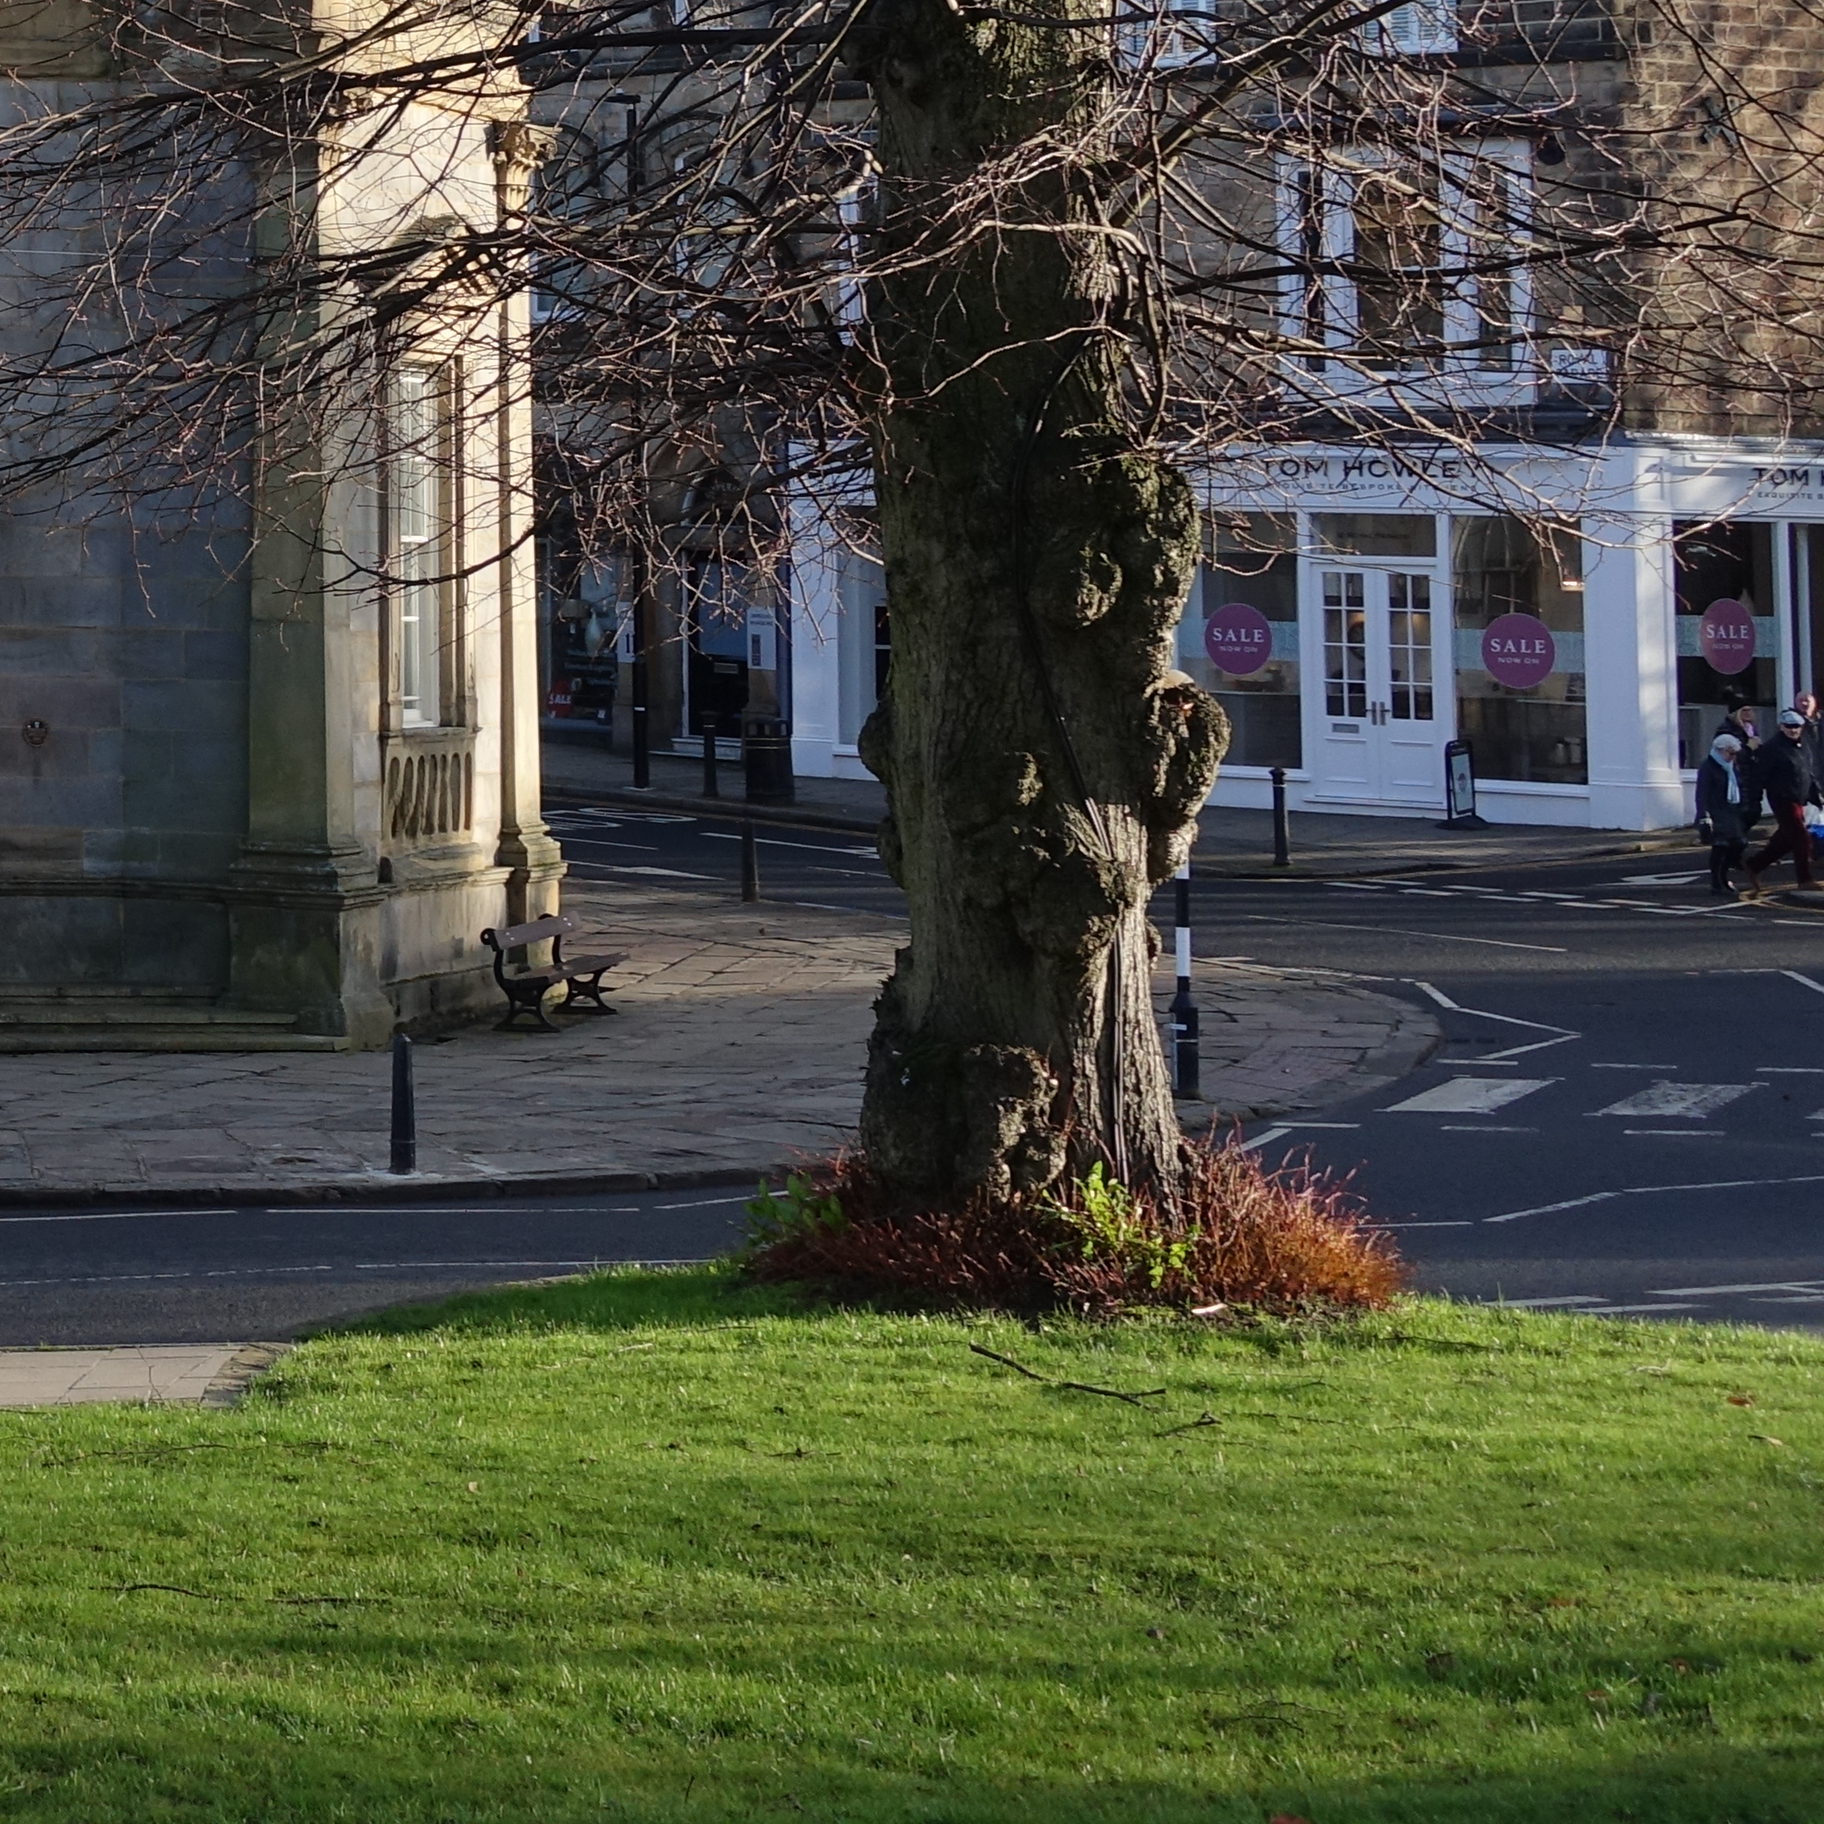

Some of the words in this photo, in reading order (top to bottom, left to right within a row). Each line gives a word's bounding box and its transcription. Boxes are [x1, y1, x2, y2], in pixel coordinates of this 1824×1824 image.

[1261, 459, 1328, 479] TOM
[1344, 459, 1481, 478] HOWLEY
[1752, 467, 1809, 486] TOM
[1213, 627, 1264, 643] SALE
[1706, 624, 1749, 639] SALE
[1490, 638, 1546, 654] SALE
